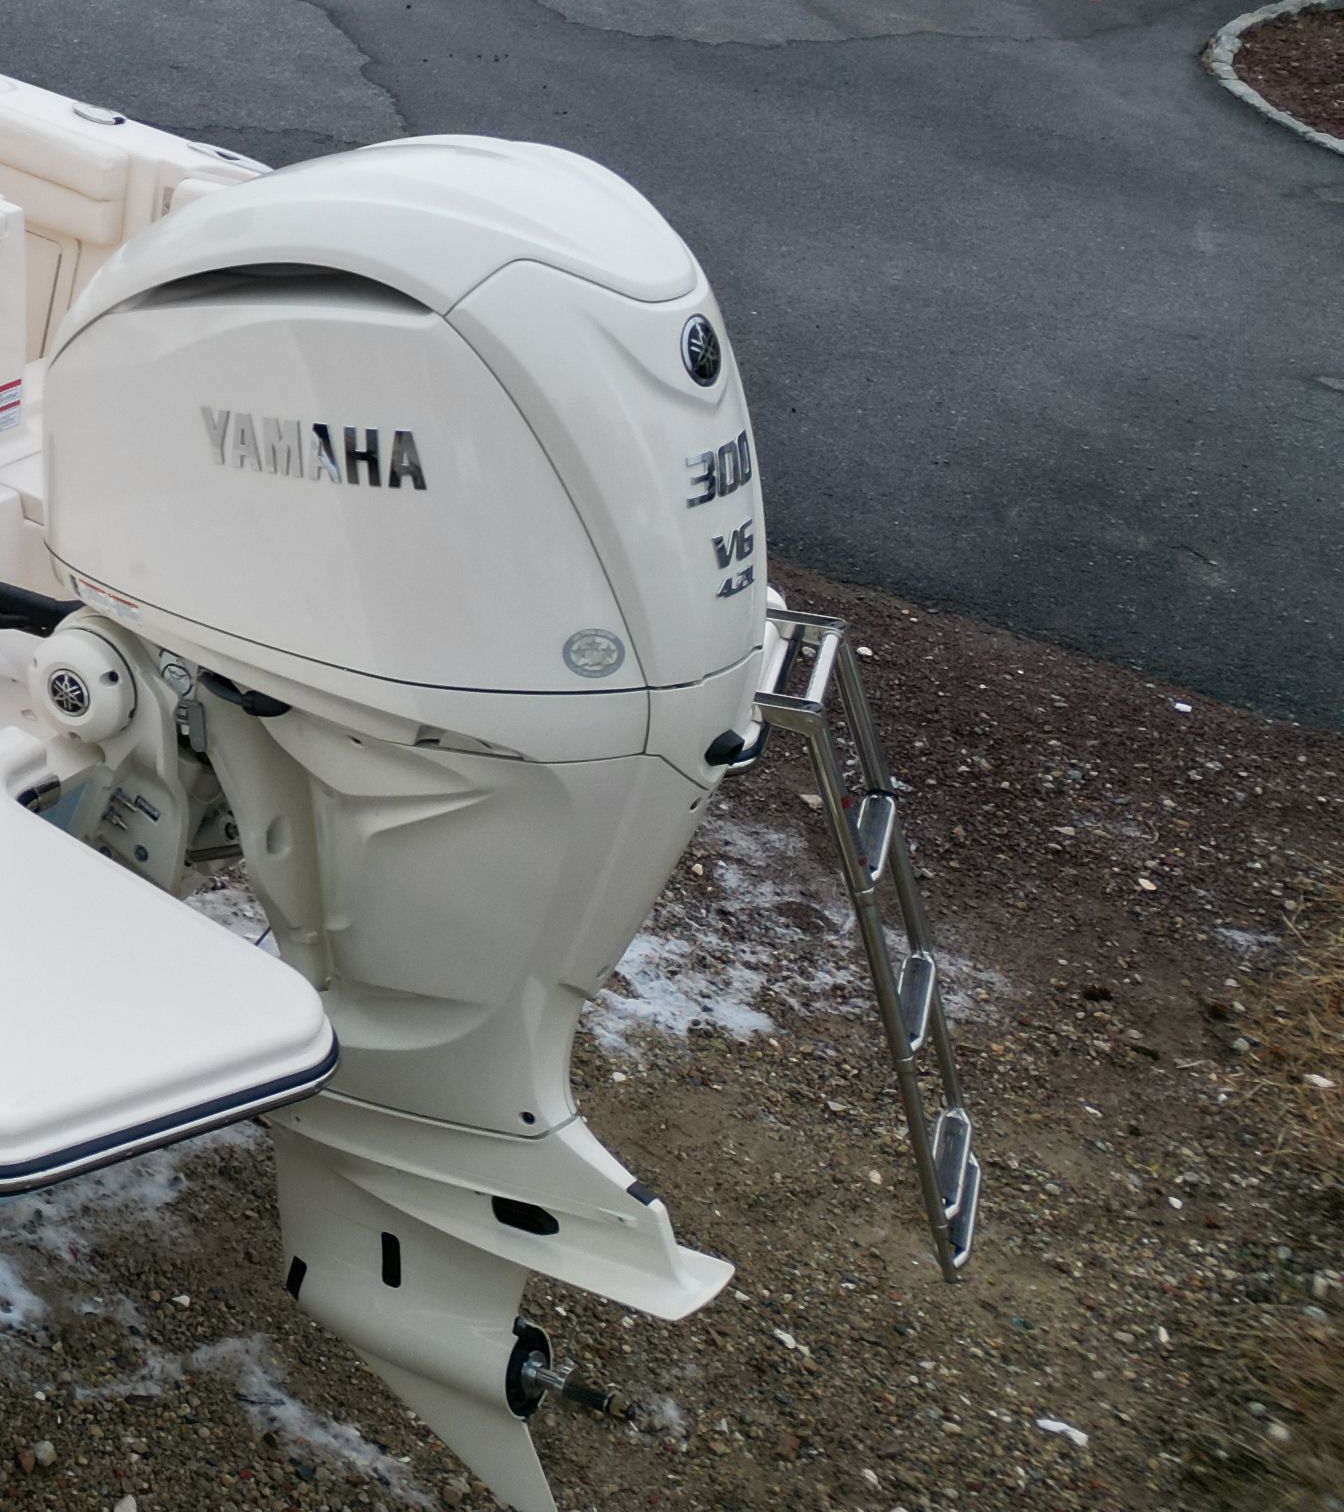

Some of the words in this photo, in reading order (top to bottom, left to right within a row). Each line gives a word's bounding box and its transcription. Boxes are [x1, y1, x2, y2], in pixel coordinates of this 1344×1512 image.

[201, 406, 427, 491] YAMAHA
[686, 430, 753, 508] 300
[712, 519, 754, 569] V6
